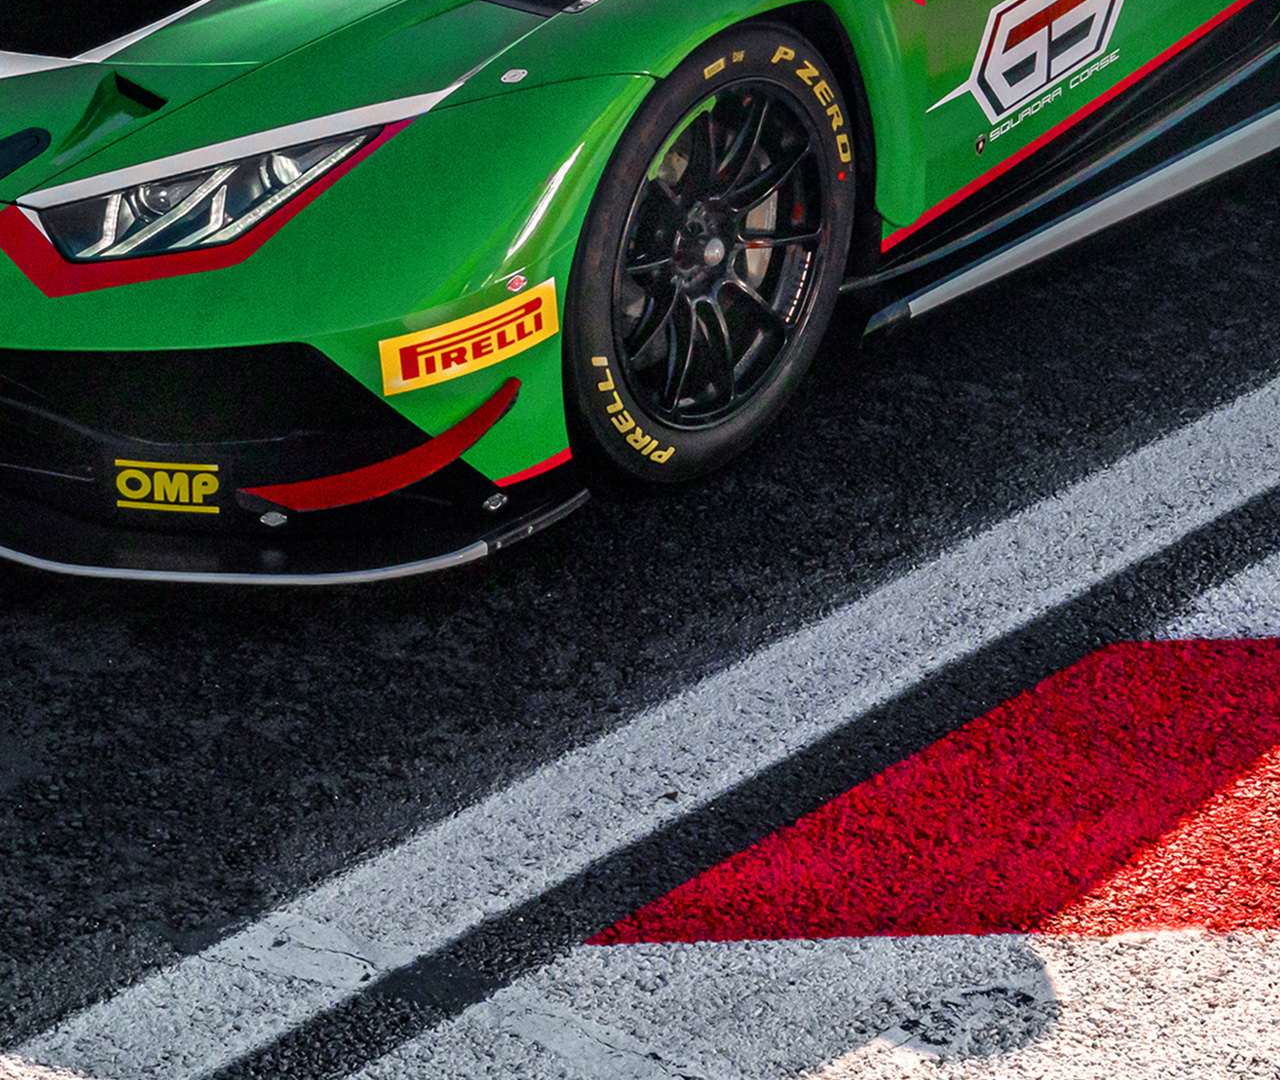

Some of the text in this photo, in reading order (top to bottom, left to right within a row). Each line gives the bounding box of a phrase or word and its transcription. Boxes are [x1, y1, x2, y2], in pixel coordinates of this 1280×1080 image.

[989, 48, 1120, 143] SQUADRA CORSE
[399, 296, 543, 381] PIRELLI
[591, 356, 676, 465] PIRELLI
[116, 468, 219, 504] OMP
